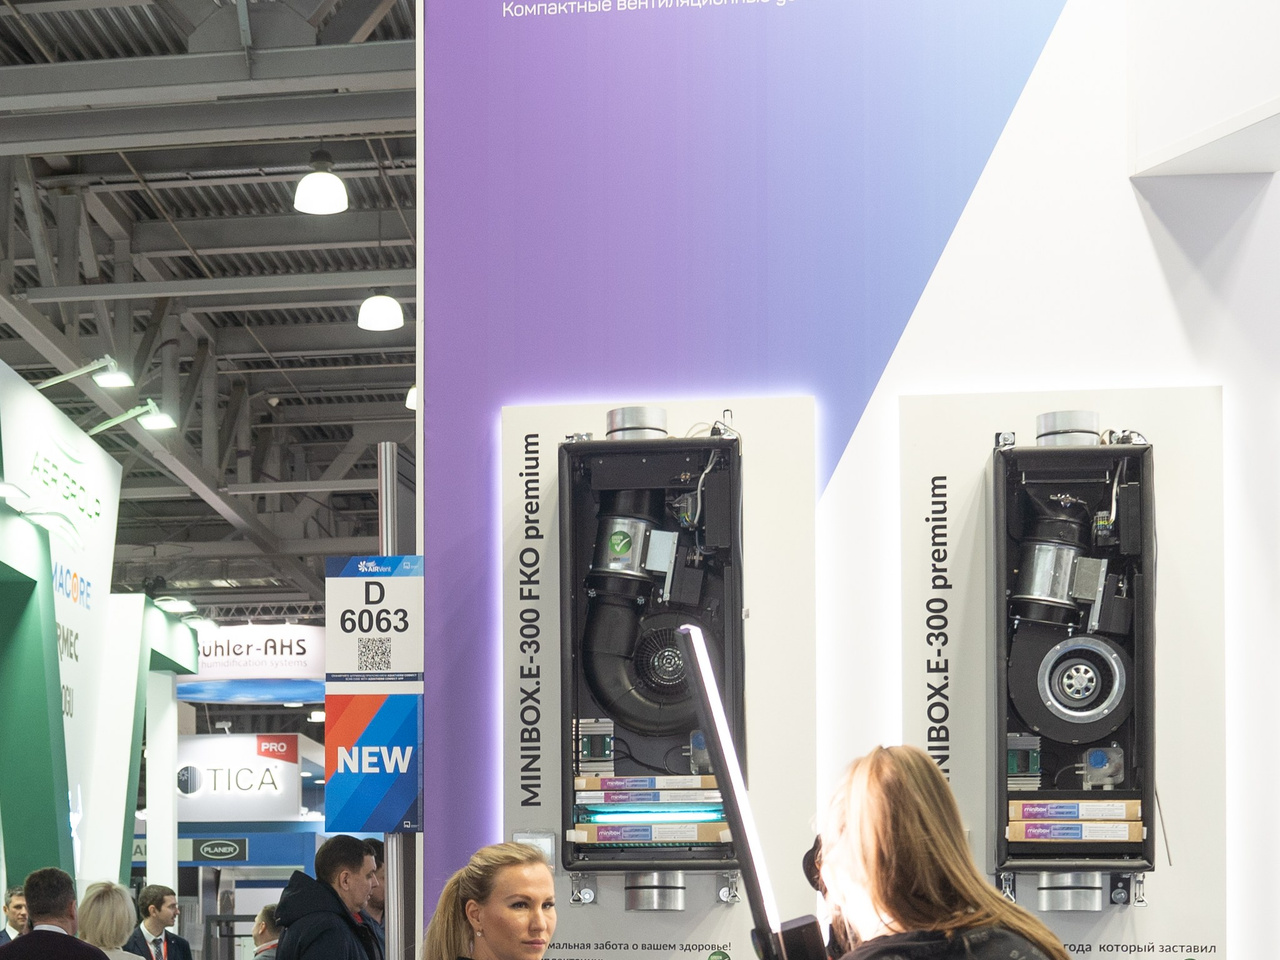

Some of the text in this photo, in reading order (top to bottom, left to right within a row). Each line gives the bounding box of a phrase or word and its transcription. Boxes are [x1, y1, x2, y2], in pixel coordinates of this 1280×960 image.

[503, 0, 611, 17] Компактные
[365, 581, 385, 605] D
[340, 609, 409, 633] 6063
[519, 433, 544, 807] MINIBOX.E-300 FKO premium
[925, 476, 952, 782] NIBOX.E-300 premium
[202, 659, 308, 670] humidification systems
[261, 742, 287, 752] PRO
[337, 746, 413, 773] NEW
[206, 768, 278, 791] TICA
[594, 941, 629, 950] забота
[641, 943, 676, 951] вашем
[679, 942, 732, 952] здоровье!
[1099, 942, 1155, 955] который
[1159, 944, 1217, 954] заставил
